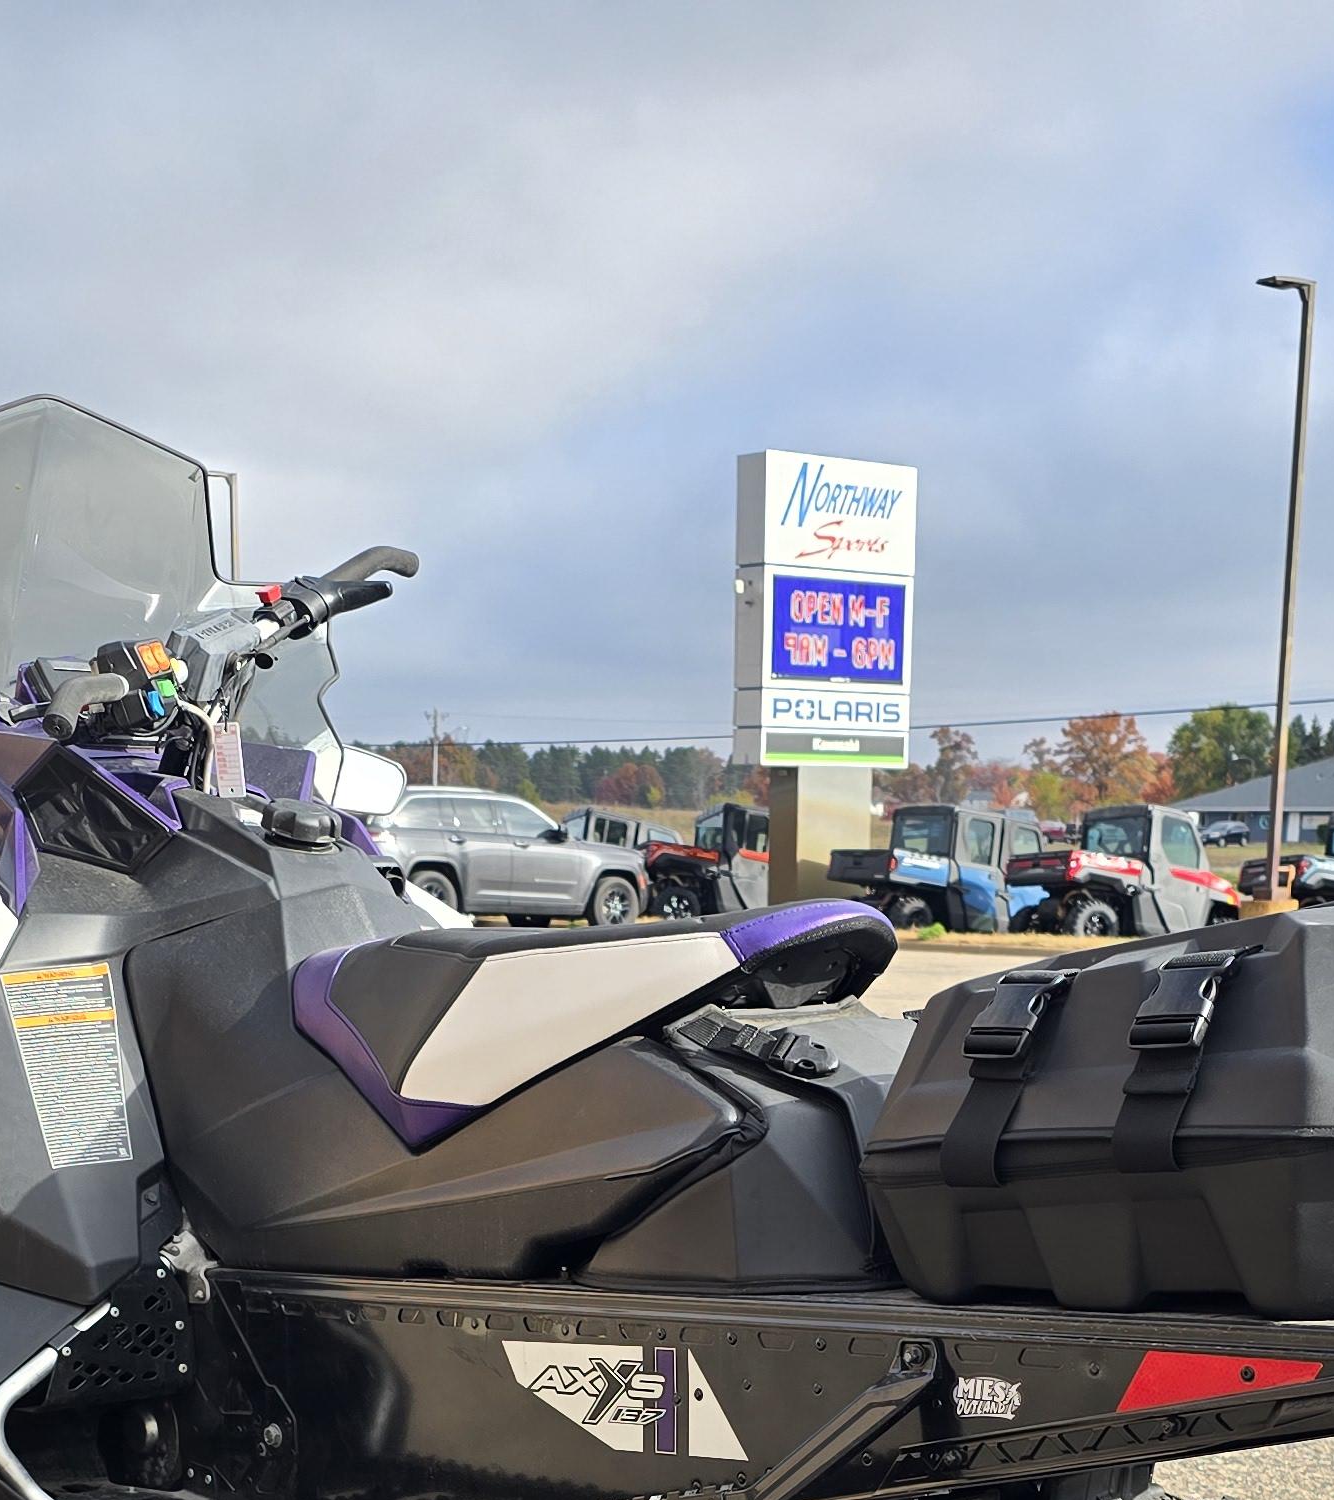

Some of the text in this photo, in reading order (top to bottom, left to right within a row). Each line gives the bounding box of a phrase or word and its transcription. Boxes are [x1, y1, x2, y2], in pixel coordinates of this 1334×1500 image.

[780, 461, 903, 527] NORTHWAY
[794, 520, 889, 559] Sports
[790, 590, 890, 628] OPEN M-F
[784, 632, 829, 667] 9AM
[852, 636, 896, 670] 6PM
[772, 698, 901, 723] POLARIS
[528, 1358, 666, 1425] AXYS
[956, 1377, 1007, 1402] MIES
[608, 1406, 667, 1425] 137
